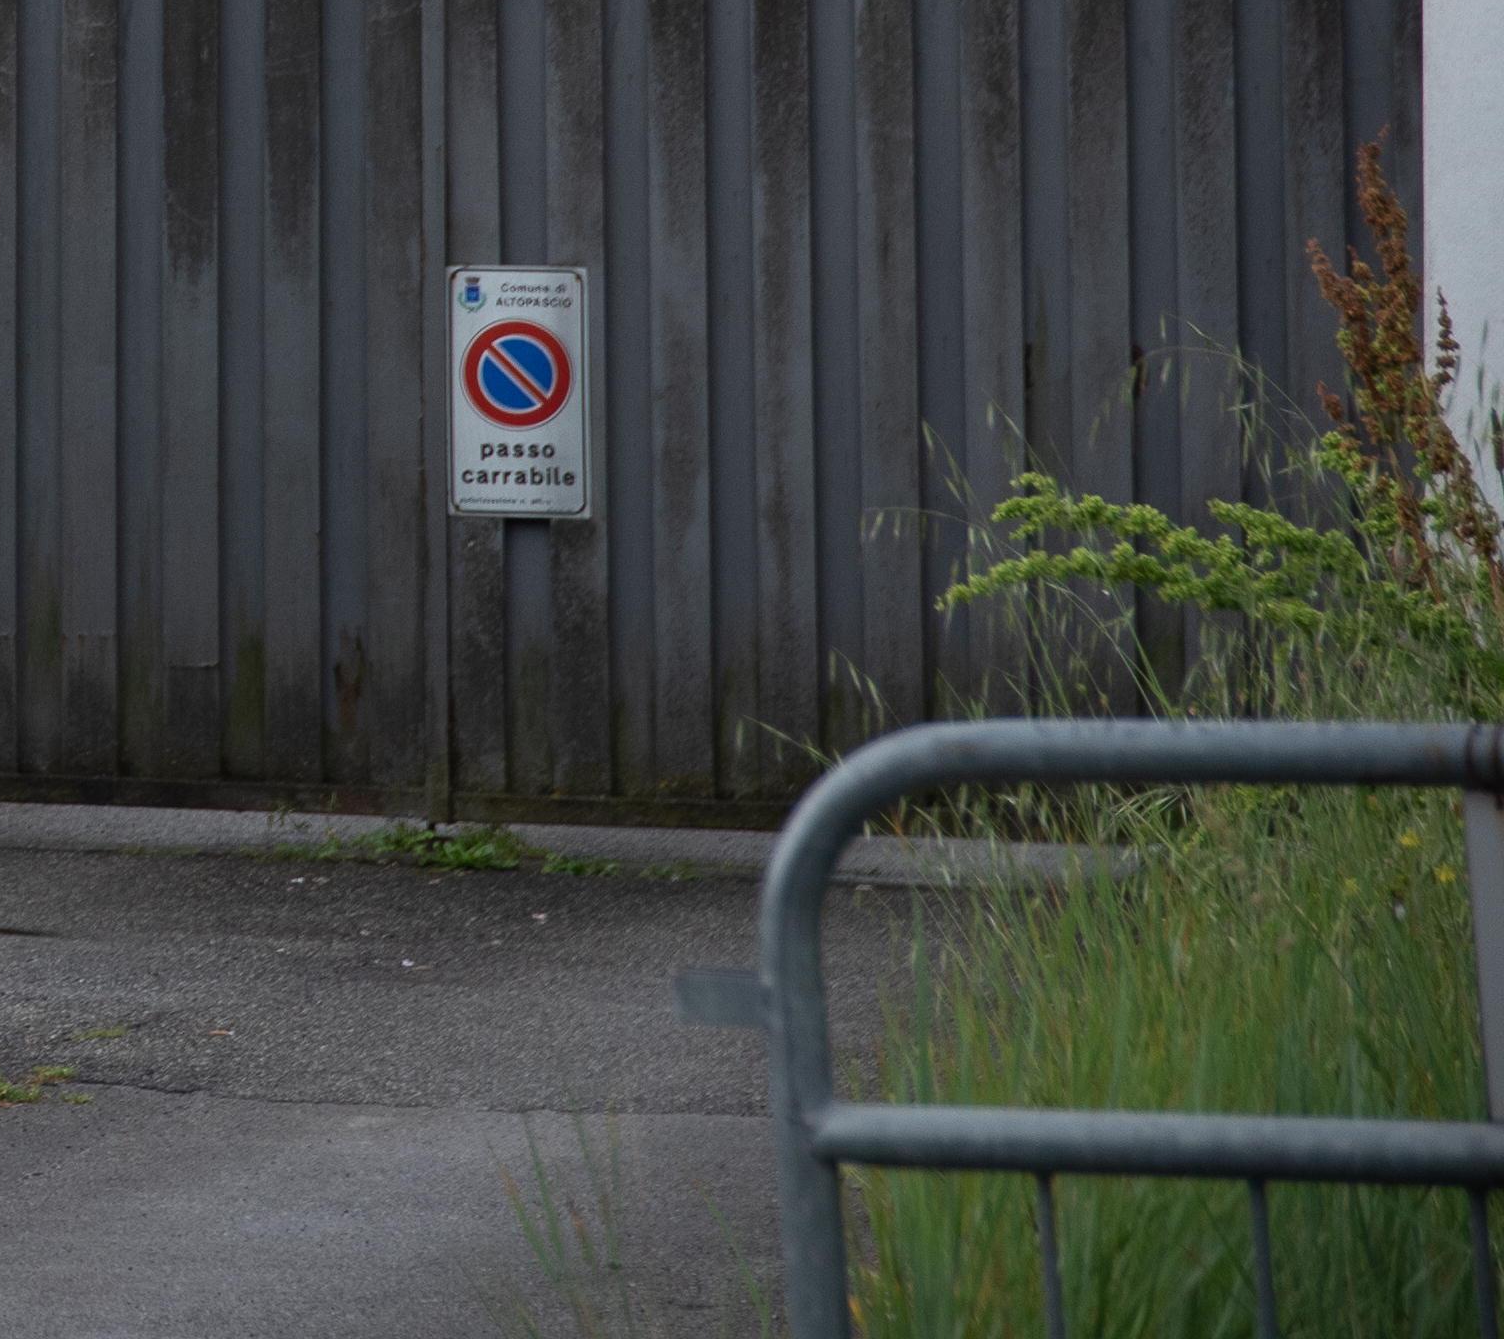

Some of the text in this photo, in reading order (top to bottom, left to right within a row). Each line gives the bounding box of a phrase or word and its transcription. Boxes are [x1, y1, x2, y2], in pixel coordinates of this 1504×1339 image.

[500, 283, 566, 294] Comune di
[496, 297, 572, 308] ALTOPASCIO
[480, 442, 555, 461] passo
[461, 468, 576, 487] carrabile
